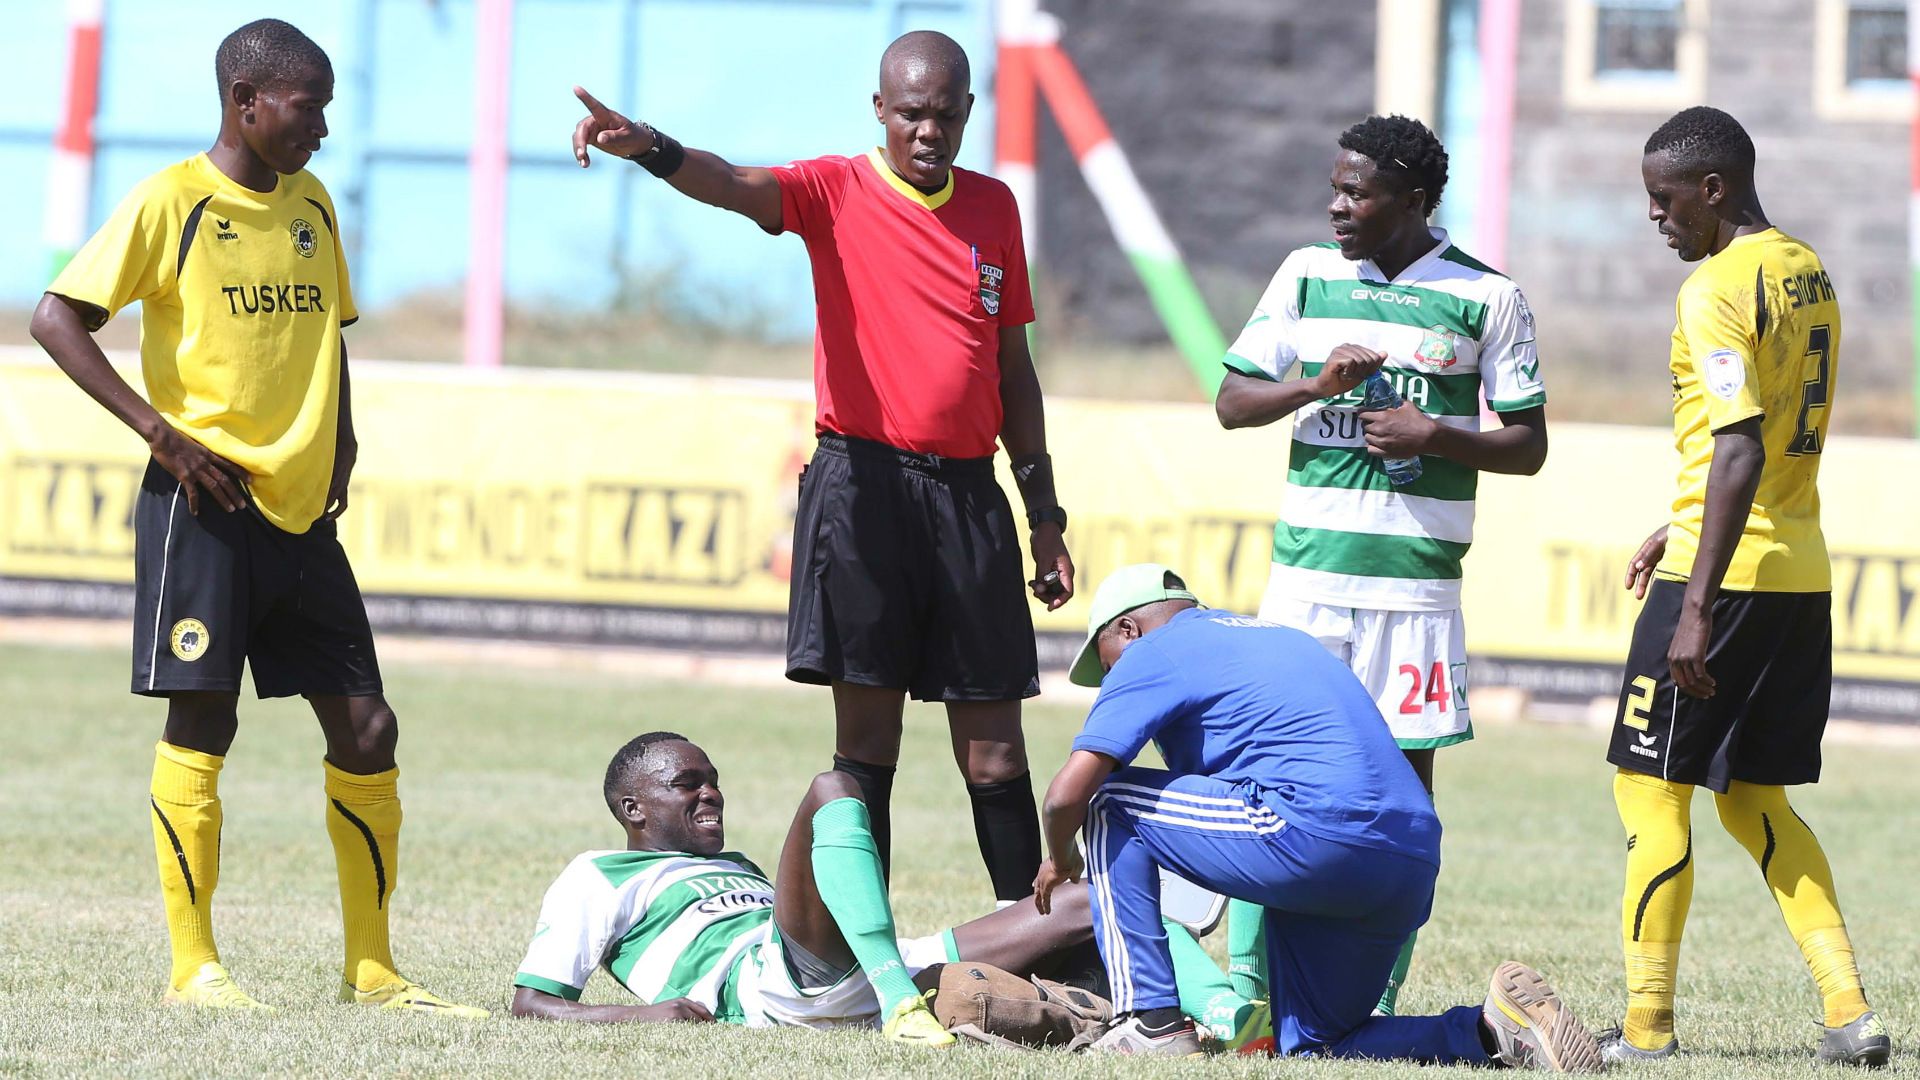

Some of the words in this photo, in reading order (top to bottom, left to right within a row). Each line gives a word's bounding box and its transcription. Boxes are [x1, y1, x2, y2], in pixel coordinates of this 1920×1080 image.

[222, 284, 325, 314] TUSKER
[1351, 289, 1420, 307] GIVOVA
[1785, 324, 1831, 457] 2
[589, 490, 740, 578] KAZI
[1399, 661, 1450, 714] 24
[1623, 675, 1657, 732] 2
[1630, 744, 1658, 759] erima
